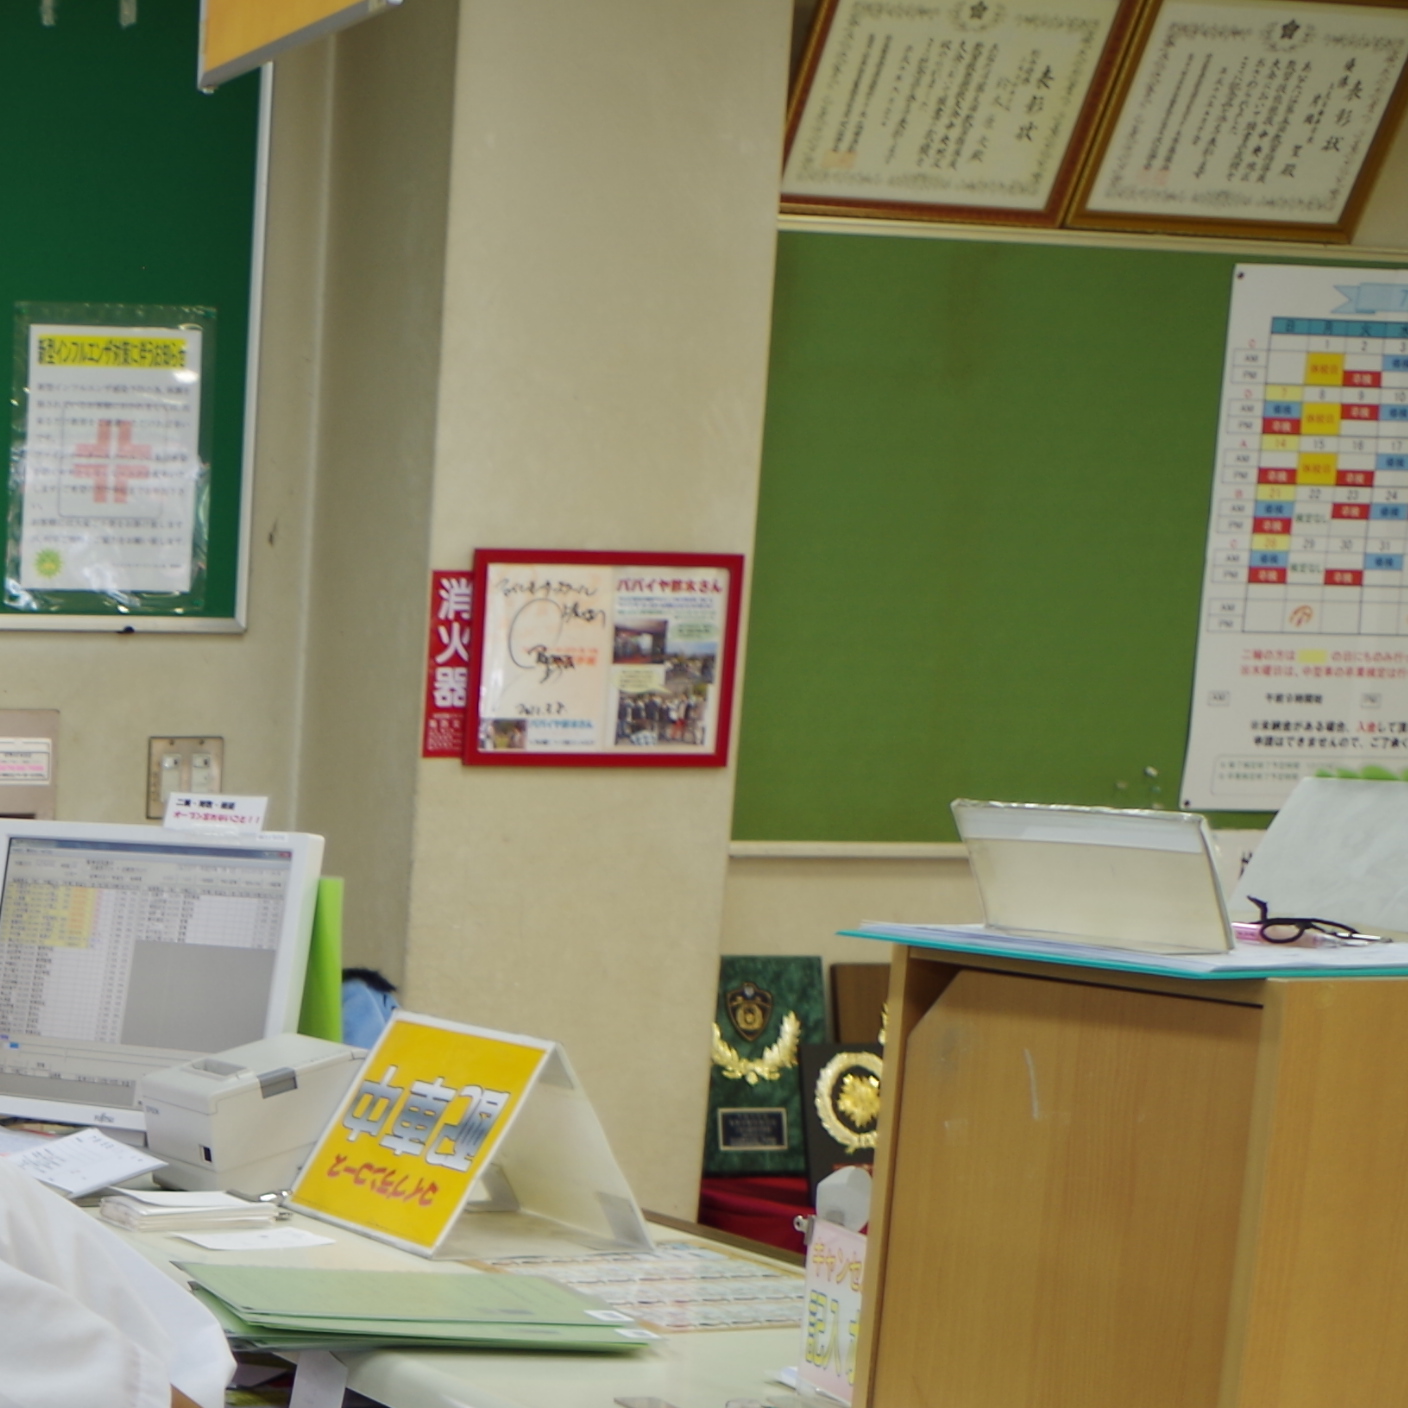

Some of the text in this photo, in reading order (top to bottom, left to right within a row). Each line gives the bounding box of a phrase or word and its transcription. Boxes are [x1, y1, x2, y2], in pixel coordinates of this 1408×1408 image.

[434, 577, 473, 708] 消火器
[342, 1063, 512, 1173] 配車中
